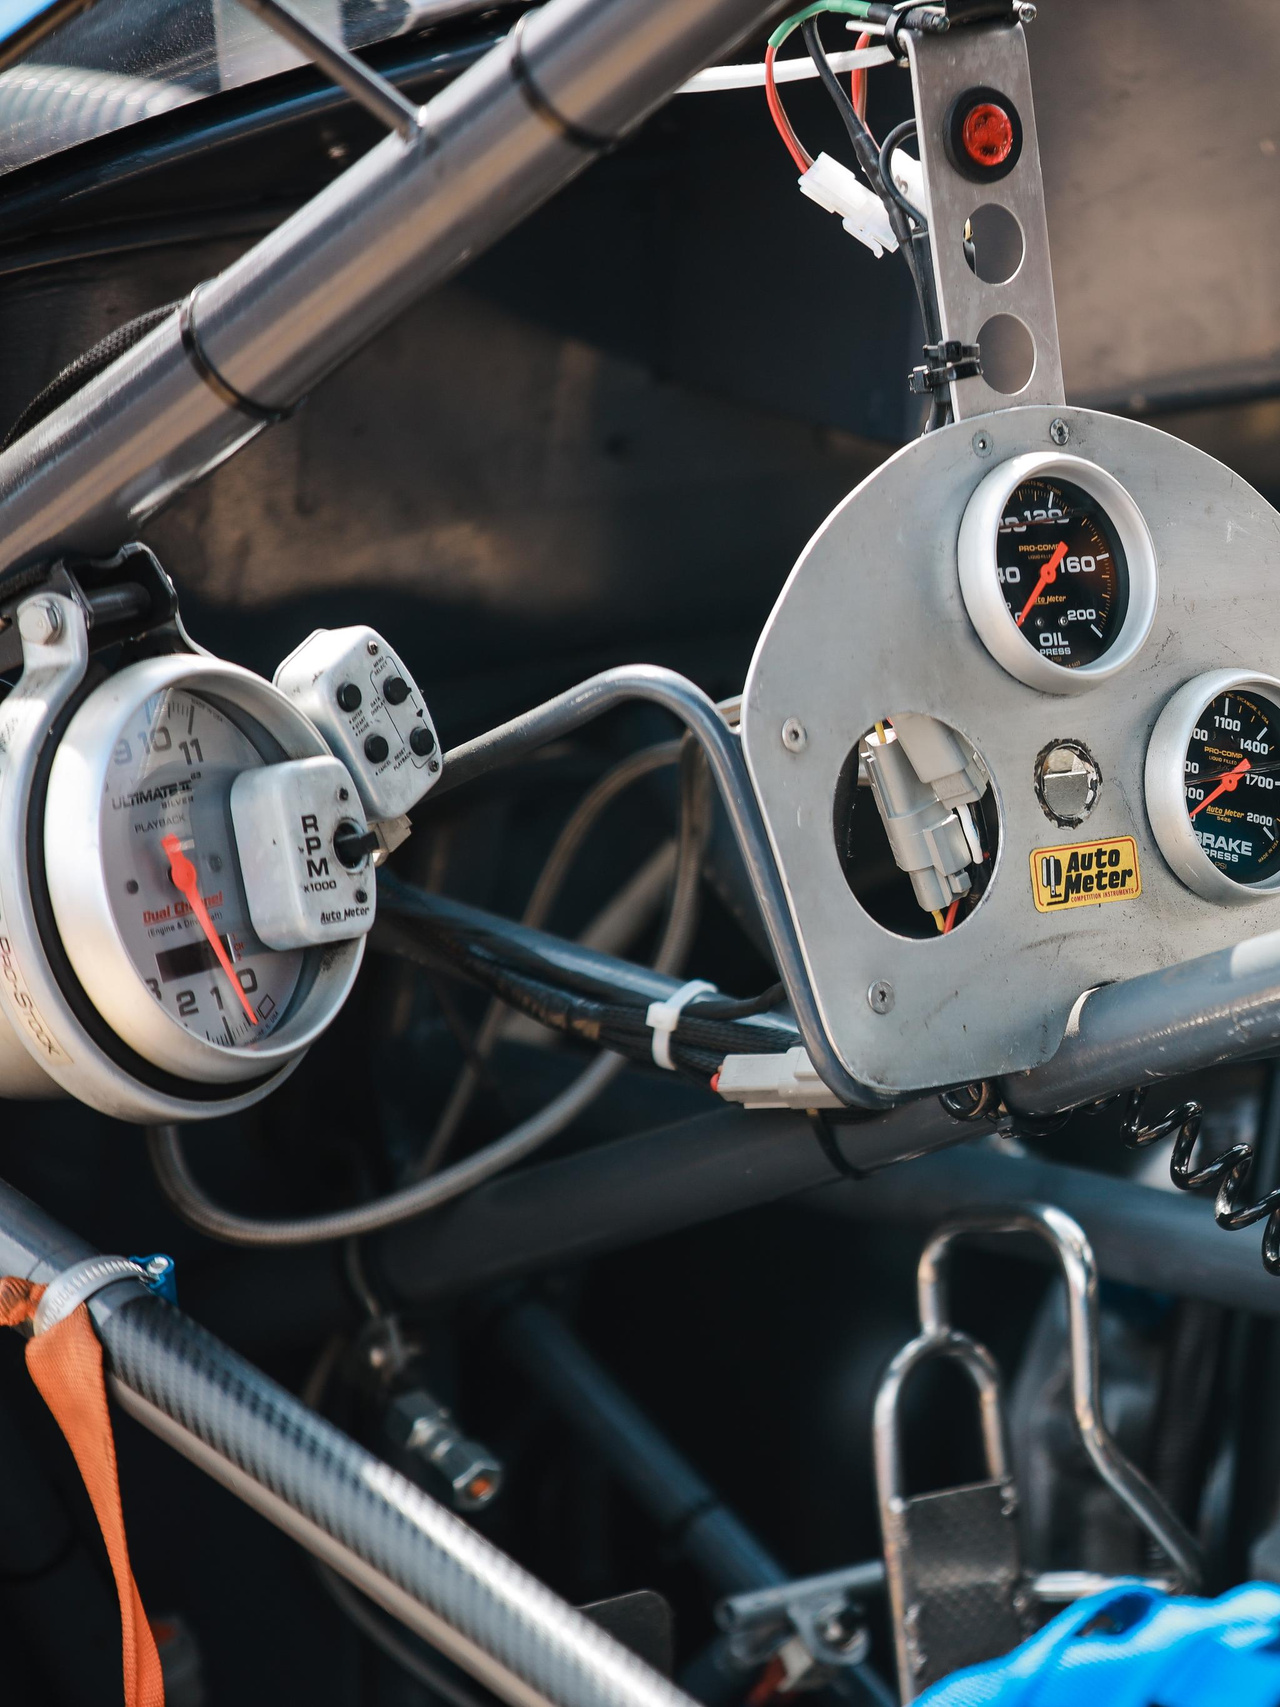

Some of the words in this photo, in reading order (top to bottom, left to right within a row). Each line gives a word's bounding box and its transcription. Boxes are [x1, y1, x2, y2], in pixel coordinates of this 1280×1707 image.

[1023, 509, 1069, 523] 120
[1060, 555, 1096, 573] 160
[1046, 595, 1067, 605] Meter
[1067, 609, 1096, 621] 200
[1039, 632, 1069, 647] OIL
[1039, 647, 1071, 657] PRESS
[1214, 715, 1241, 732] 1100
[137, 726, 172, 755] 10
[1240, 738, 1269, 755] 1400
[113, 738, 132, 766] 9
[178, 738, 204, 766] 11
[1204, 746, 1243, 759] PRO-COMP
[1244, 774, 1274, 790] 1700
[112, 782, 178, 810] ULTIMATE
[161, 795, 194, 809] SILVER
[1206, 805, 1224, 814] Auto
[1223, 809, 1245, 818] Meter
[1247, 812, 1273, 827] 2000
[134, 813, 187, 834] PLAYBACK
[1194, 830, 1252, 856] BRAKE
[1066, 848, 1121, 874] Auto
[1203, 848, 1239, 863] PRESS
[1063, 869, 1133, 904] Meter
[1070, 892, 1102, 903] COMPETITION
[1102, 887, 1135, 898] INSTRUMENTS
[142, 905, 171, 925] Dual
[320, 911, 342, 925] Auto
[343, 906, 370, 921] Meter
[147, 925, 176, 940] (Engine
[236, 967, 258, 994] 0
[176, 990, 199, 1017] 2
[209, 986, 224, 1010] 1
